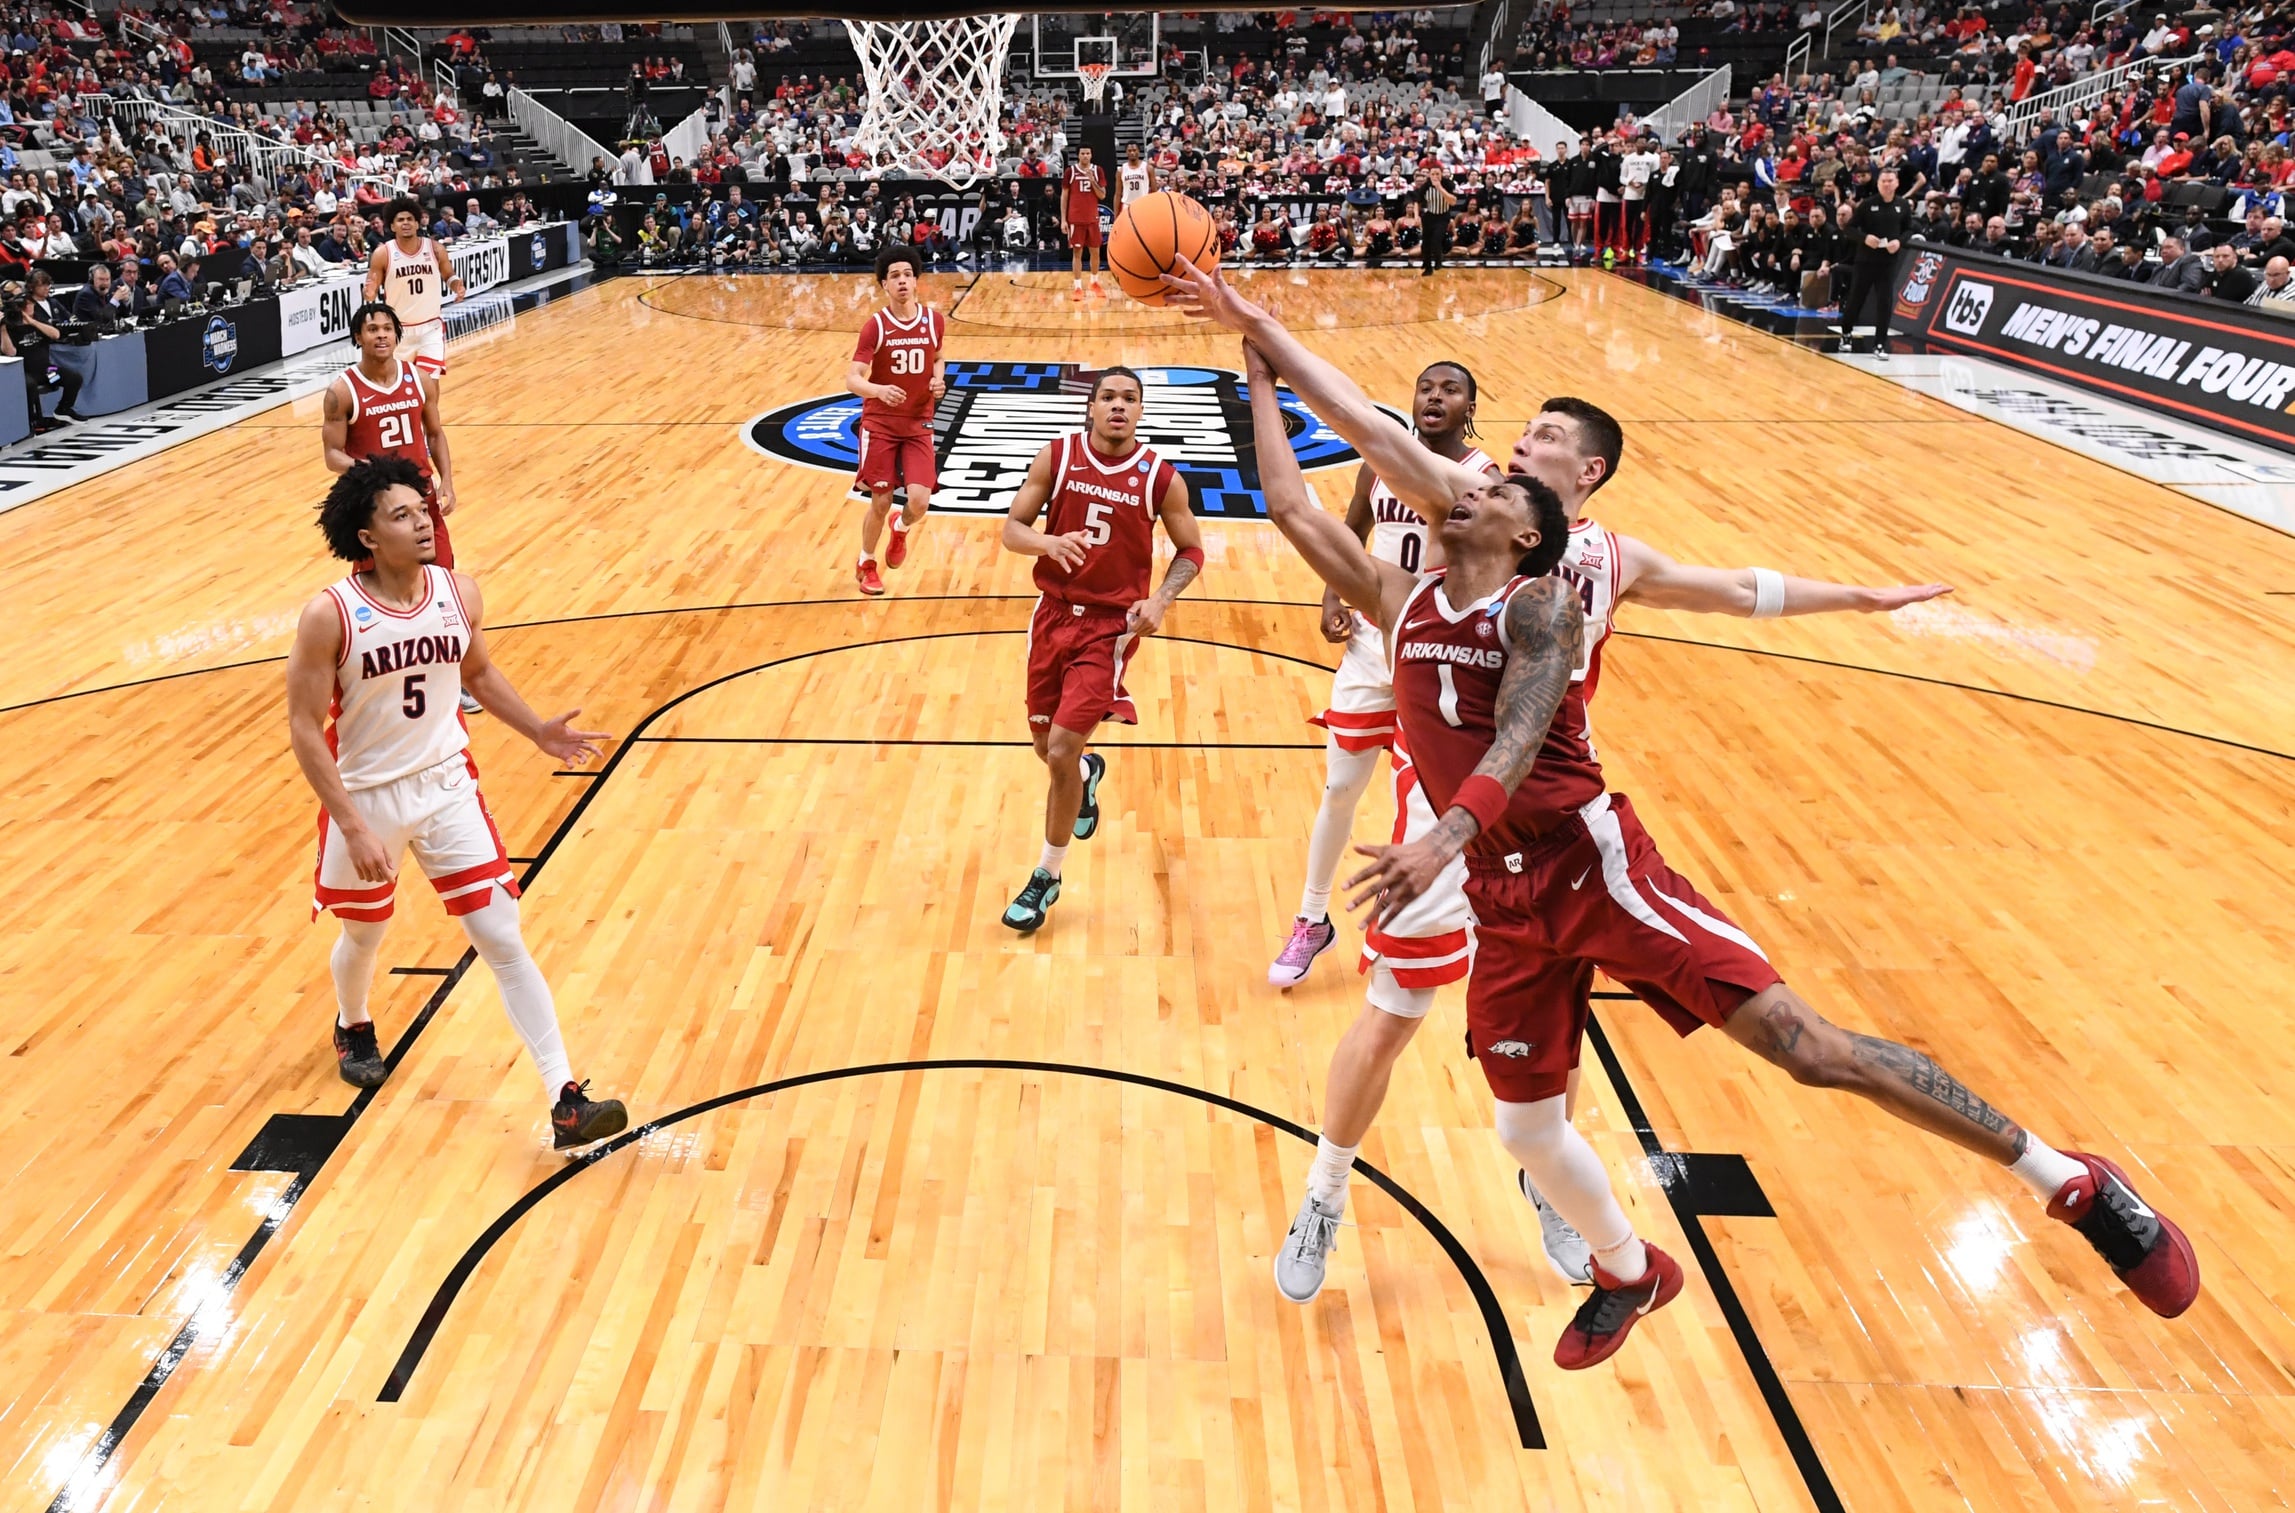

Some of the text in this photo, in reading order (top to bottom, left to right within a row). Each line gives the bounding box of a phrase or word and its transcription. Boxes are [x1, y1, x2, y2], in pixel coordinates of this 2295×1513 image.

[1079, 180, 1091, 192] 12
[1129, 181, 1140, 191] 30
[396, 264, 433, 279] ARIZONA
[407, 278, 424, 295] 10
[320, 287, 352, 335] SAN
[1951, 288, 1985, 326] tbs
[885, 337, 930, 347] ARKANSAS
[2001, 302, 2295, 410] MEN'S FINAL FOUR
[890, 348, 925, 374] 30
[365, 398, 419, 416] ARKANSAS
[796, 407, 863, 431] ELITE
[378, 413, 414, 448] 21
[928, 393, 1089, 510] MADNESS
[1066, 480, 1140, 506] ARKANSAS
[1085, 502, 1113, 545] 5
[1401, 532, 1421, 574] 0
[361, 635, 461, 680] ARIZONA
[1400, 642, 1502, 668] ARKANSAS
[402, 673, 426, 719] 5
[1437, 664, 1463, 727] 1
